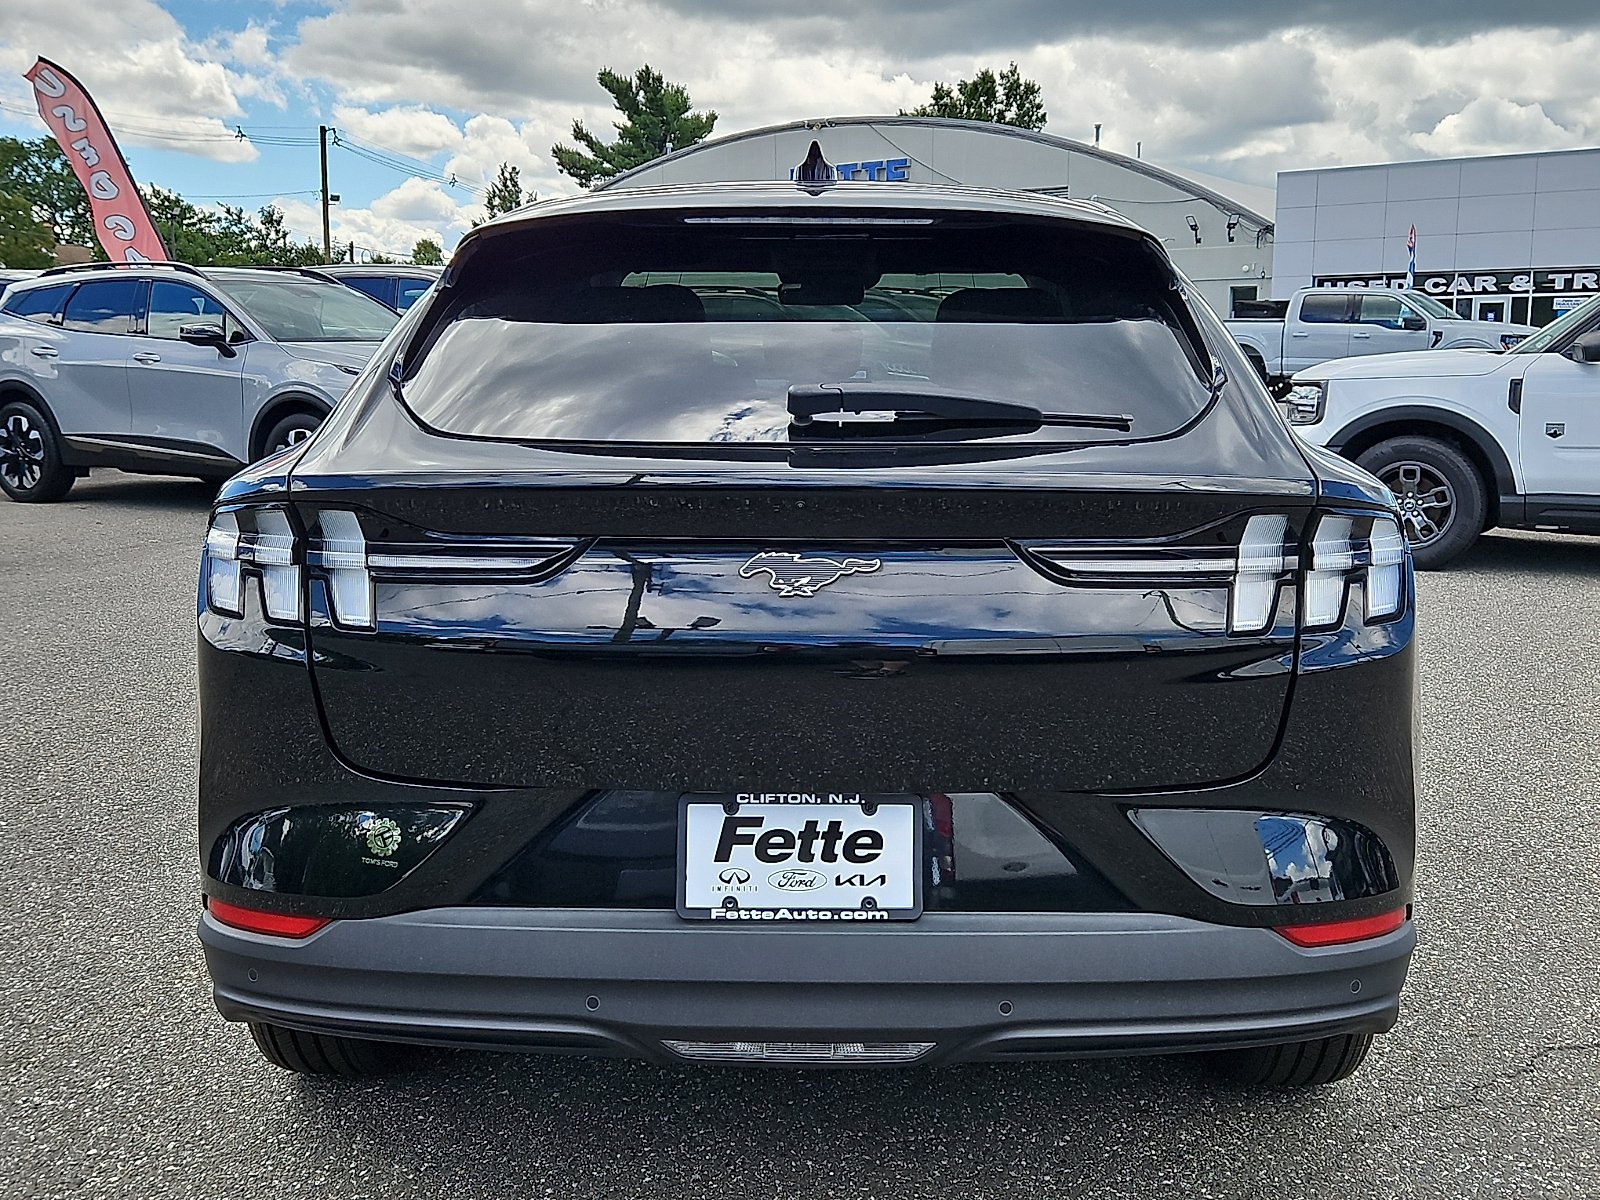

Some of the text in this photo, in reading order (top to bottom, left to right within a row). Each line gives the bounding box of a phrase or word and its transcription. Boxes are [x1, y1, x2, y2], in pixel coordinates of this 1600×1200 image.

[789, 158, 911, 181] TTE
[1424, 275, 1498, 294] CAR
[1508, 275, 1536, 291] &
[736, 793, 866, 805] CLIFTON, N.J.
[713, 816, 884, 864] Fette
[777, 871, 818, 888] Ford
[835, 874, 886, 887] KIA
[711, 908, 889, 920] FetteAuto.com
